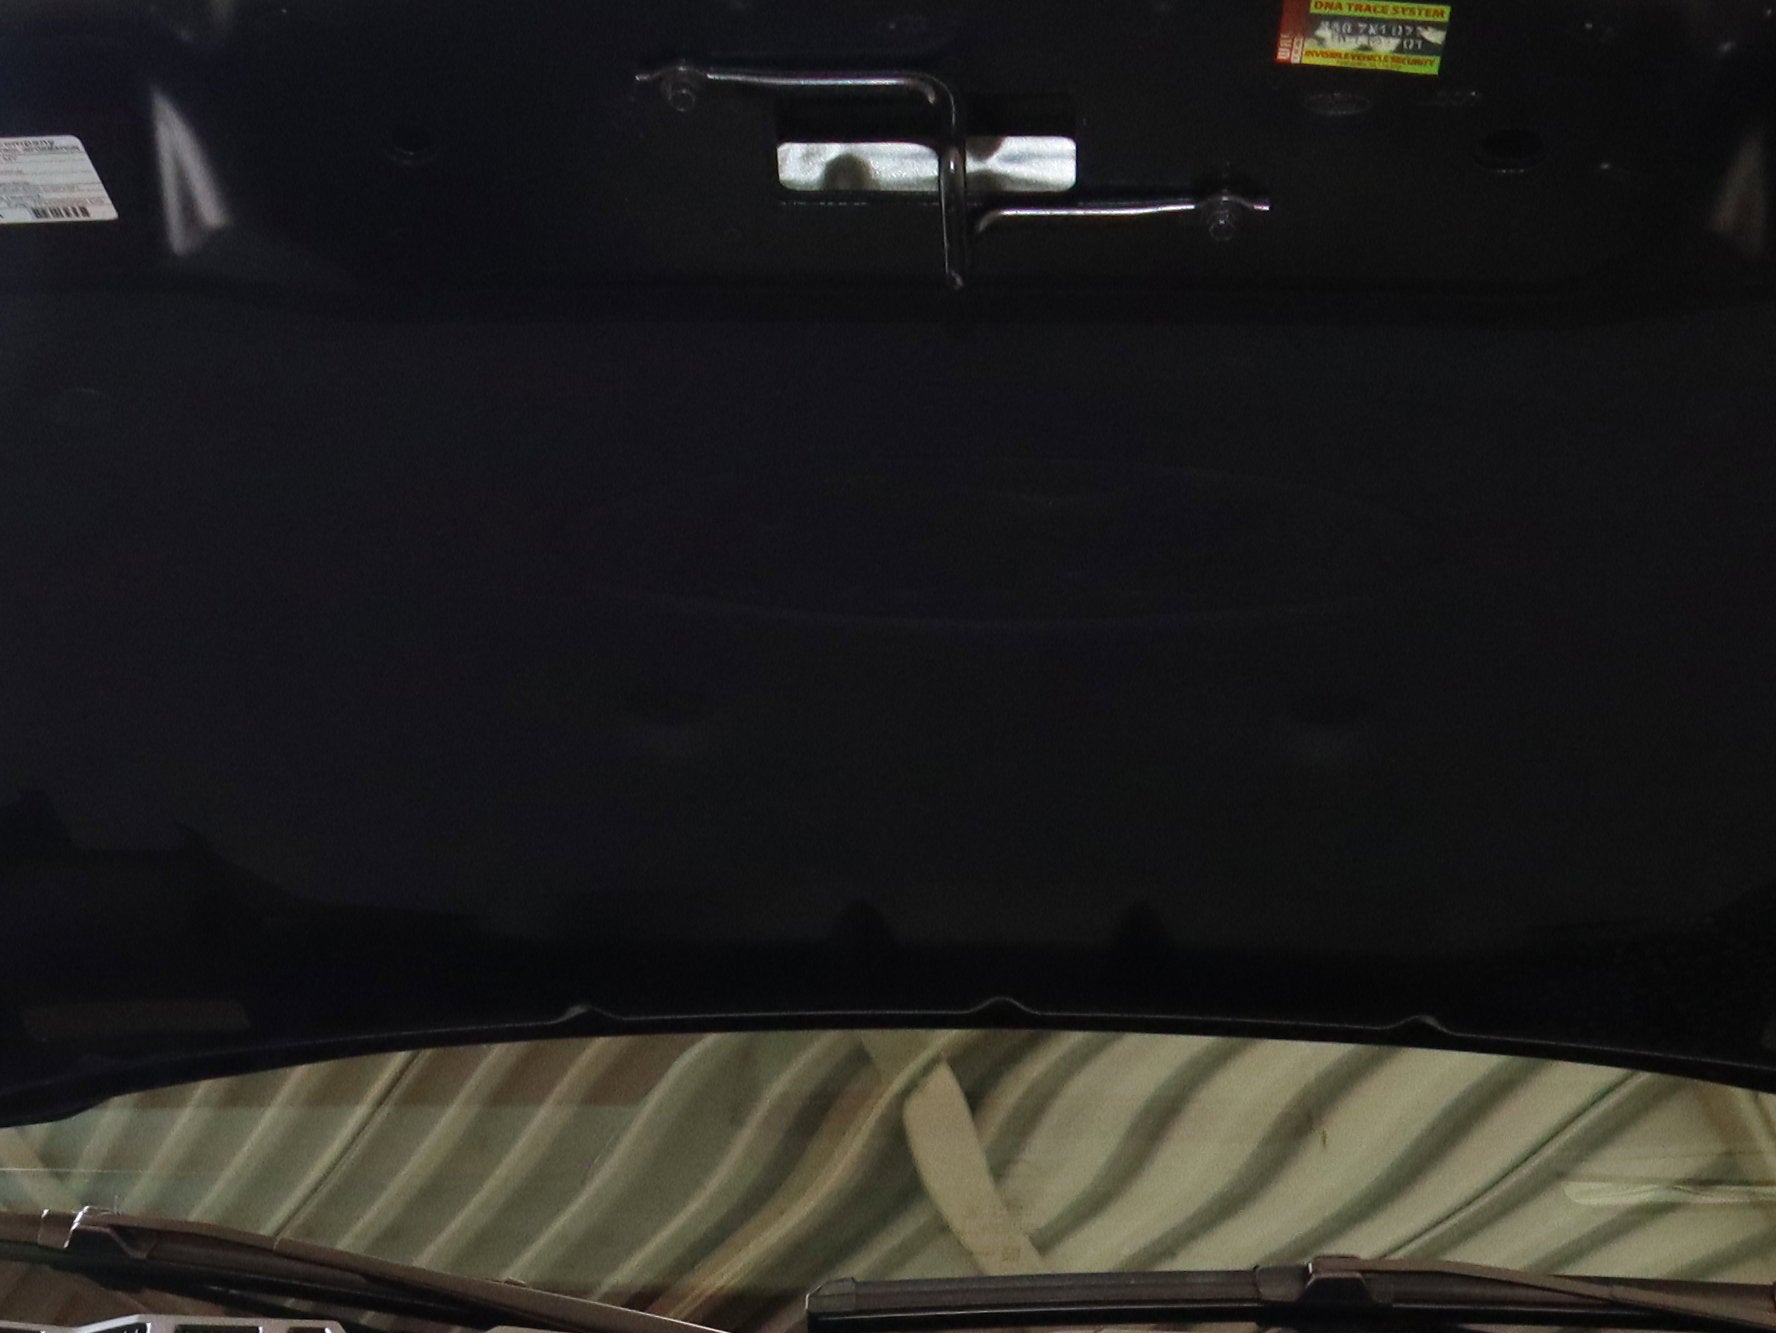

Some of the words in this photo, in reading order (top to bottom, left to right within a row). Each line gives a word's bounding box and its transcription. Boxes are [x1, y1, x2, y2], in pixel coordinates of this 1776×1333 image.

[1314, 1, 1343, 11] DNA
[1348, 3, 1388, 15] TRACE
[1390, 6, 1446, 19] SYSTEM
